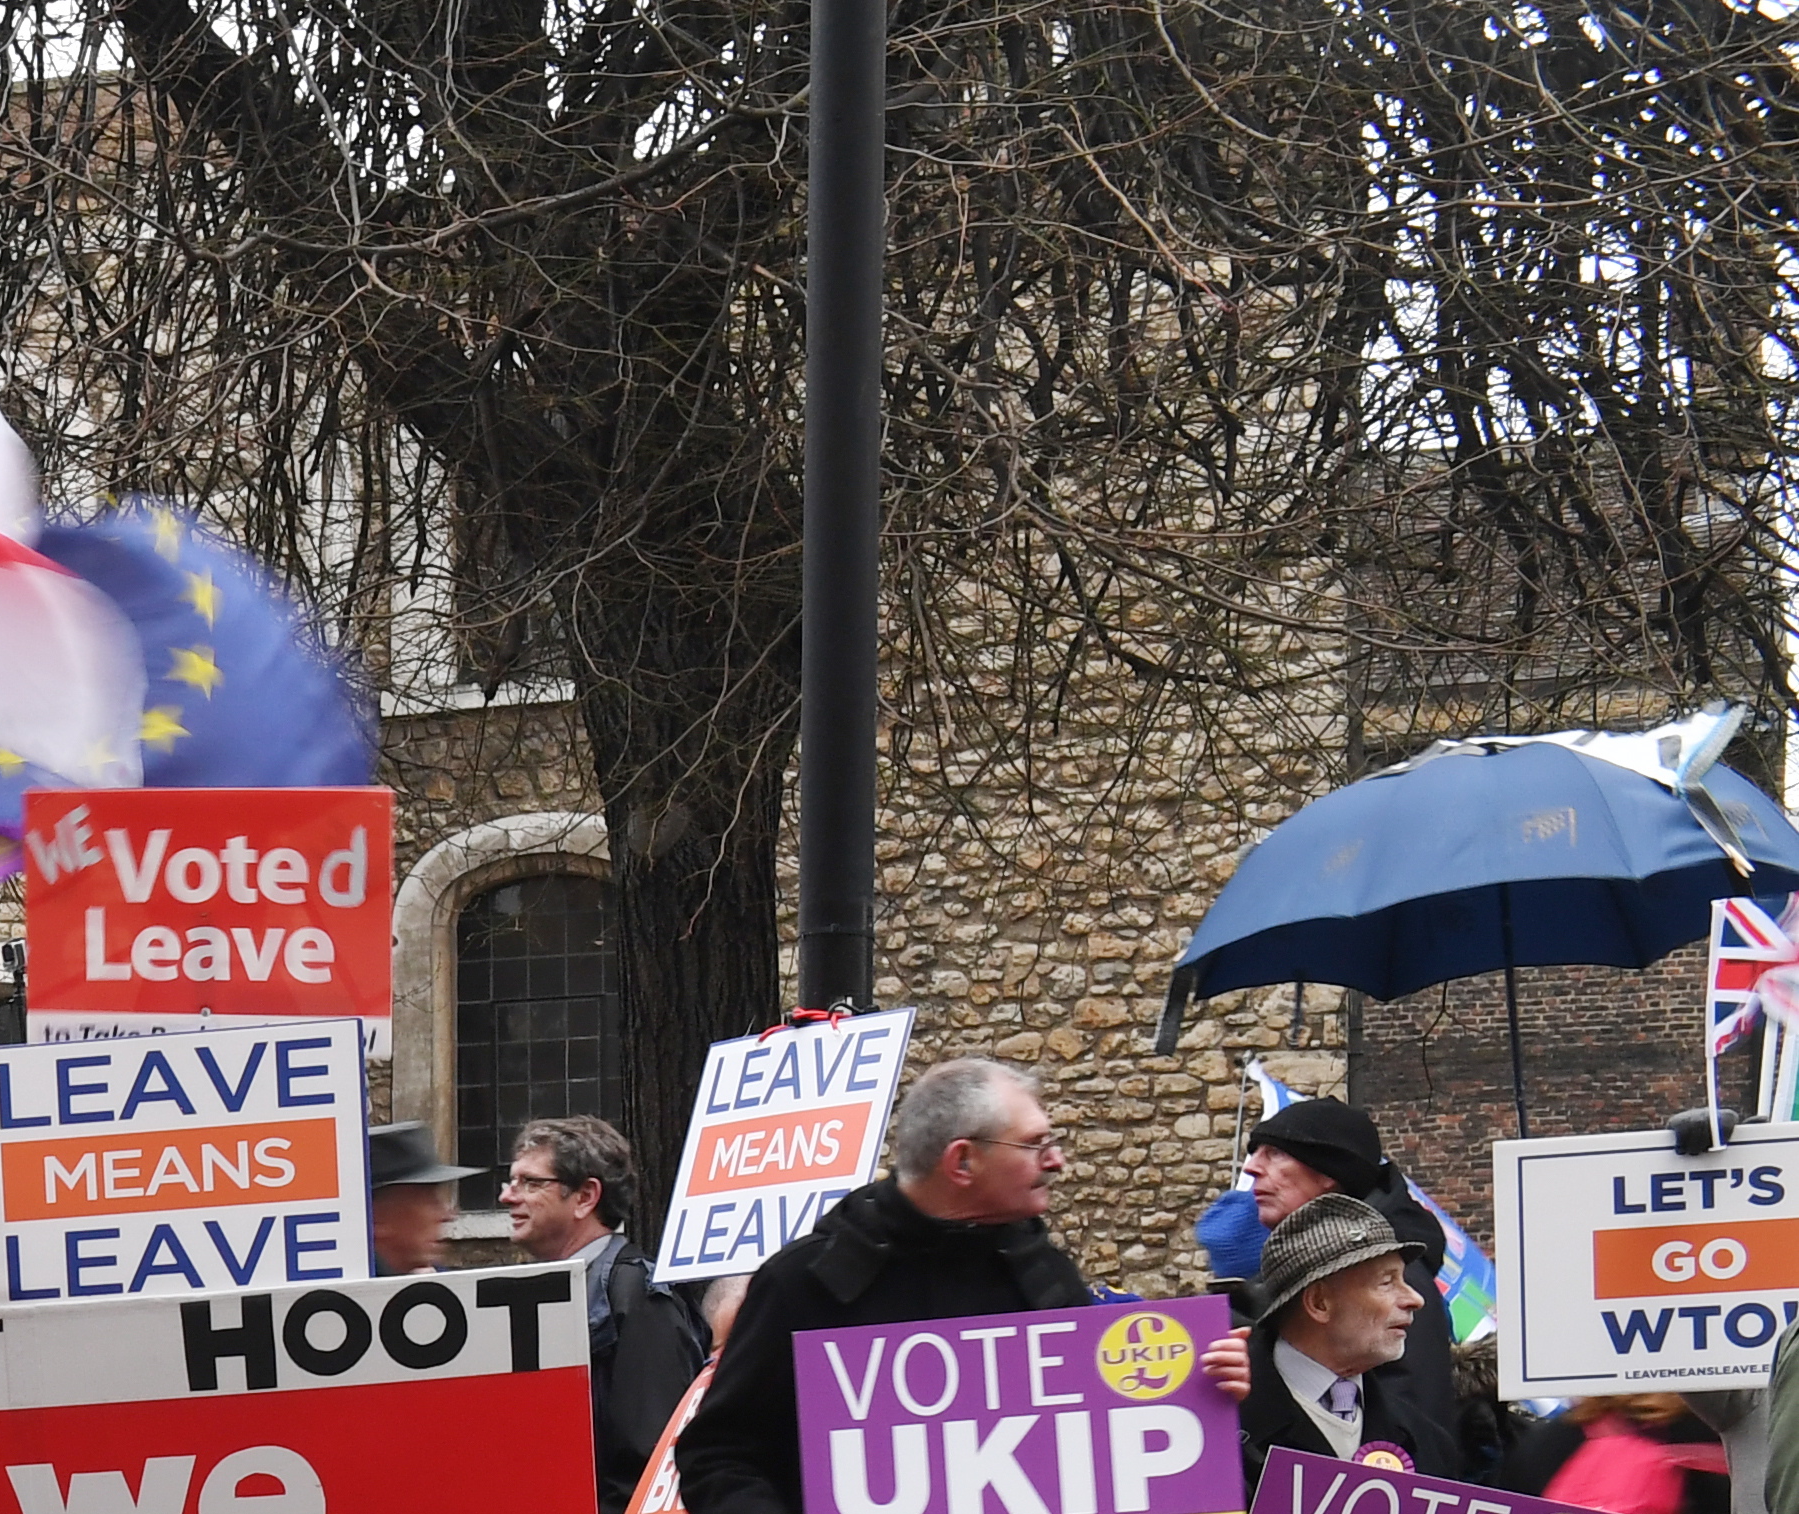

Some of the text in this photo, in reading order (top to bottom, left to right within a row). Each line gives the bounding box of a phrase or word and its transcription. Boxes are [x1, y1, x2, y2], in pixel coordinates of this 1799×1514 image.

[103, 824, 367, 908] Voted
[84, 906, 335, 984] Leave
[705, 1027, 891, 1116] LEAVE
[43, 1136, 296, 1204] MEANS
[708, 1119, 844, 1180] MEANS
[1613, 1165, 1786, 1215] LET'S
[5, 1211, 344, 1301] LEAVE
[1652, 1237, 1748, 1283] GO
[179, 1270, 571, 1392] HOOT
[1102, 1343, 1188, 1365] UKIP
[823, 1320, 1085, 1422] VOTE
[1624, 1363, 1771, 1380] LEAVEMEANSLEAVE.E
